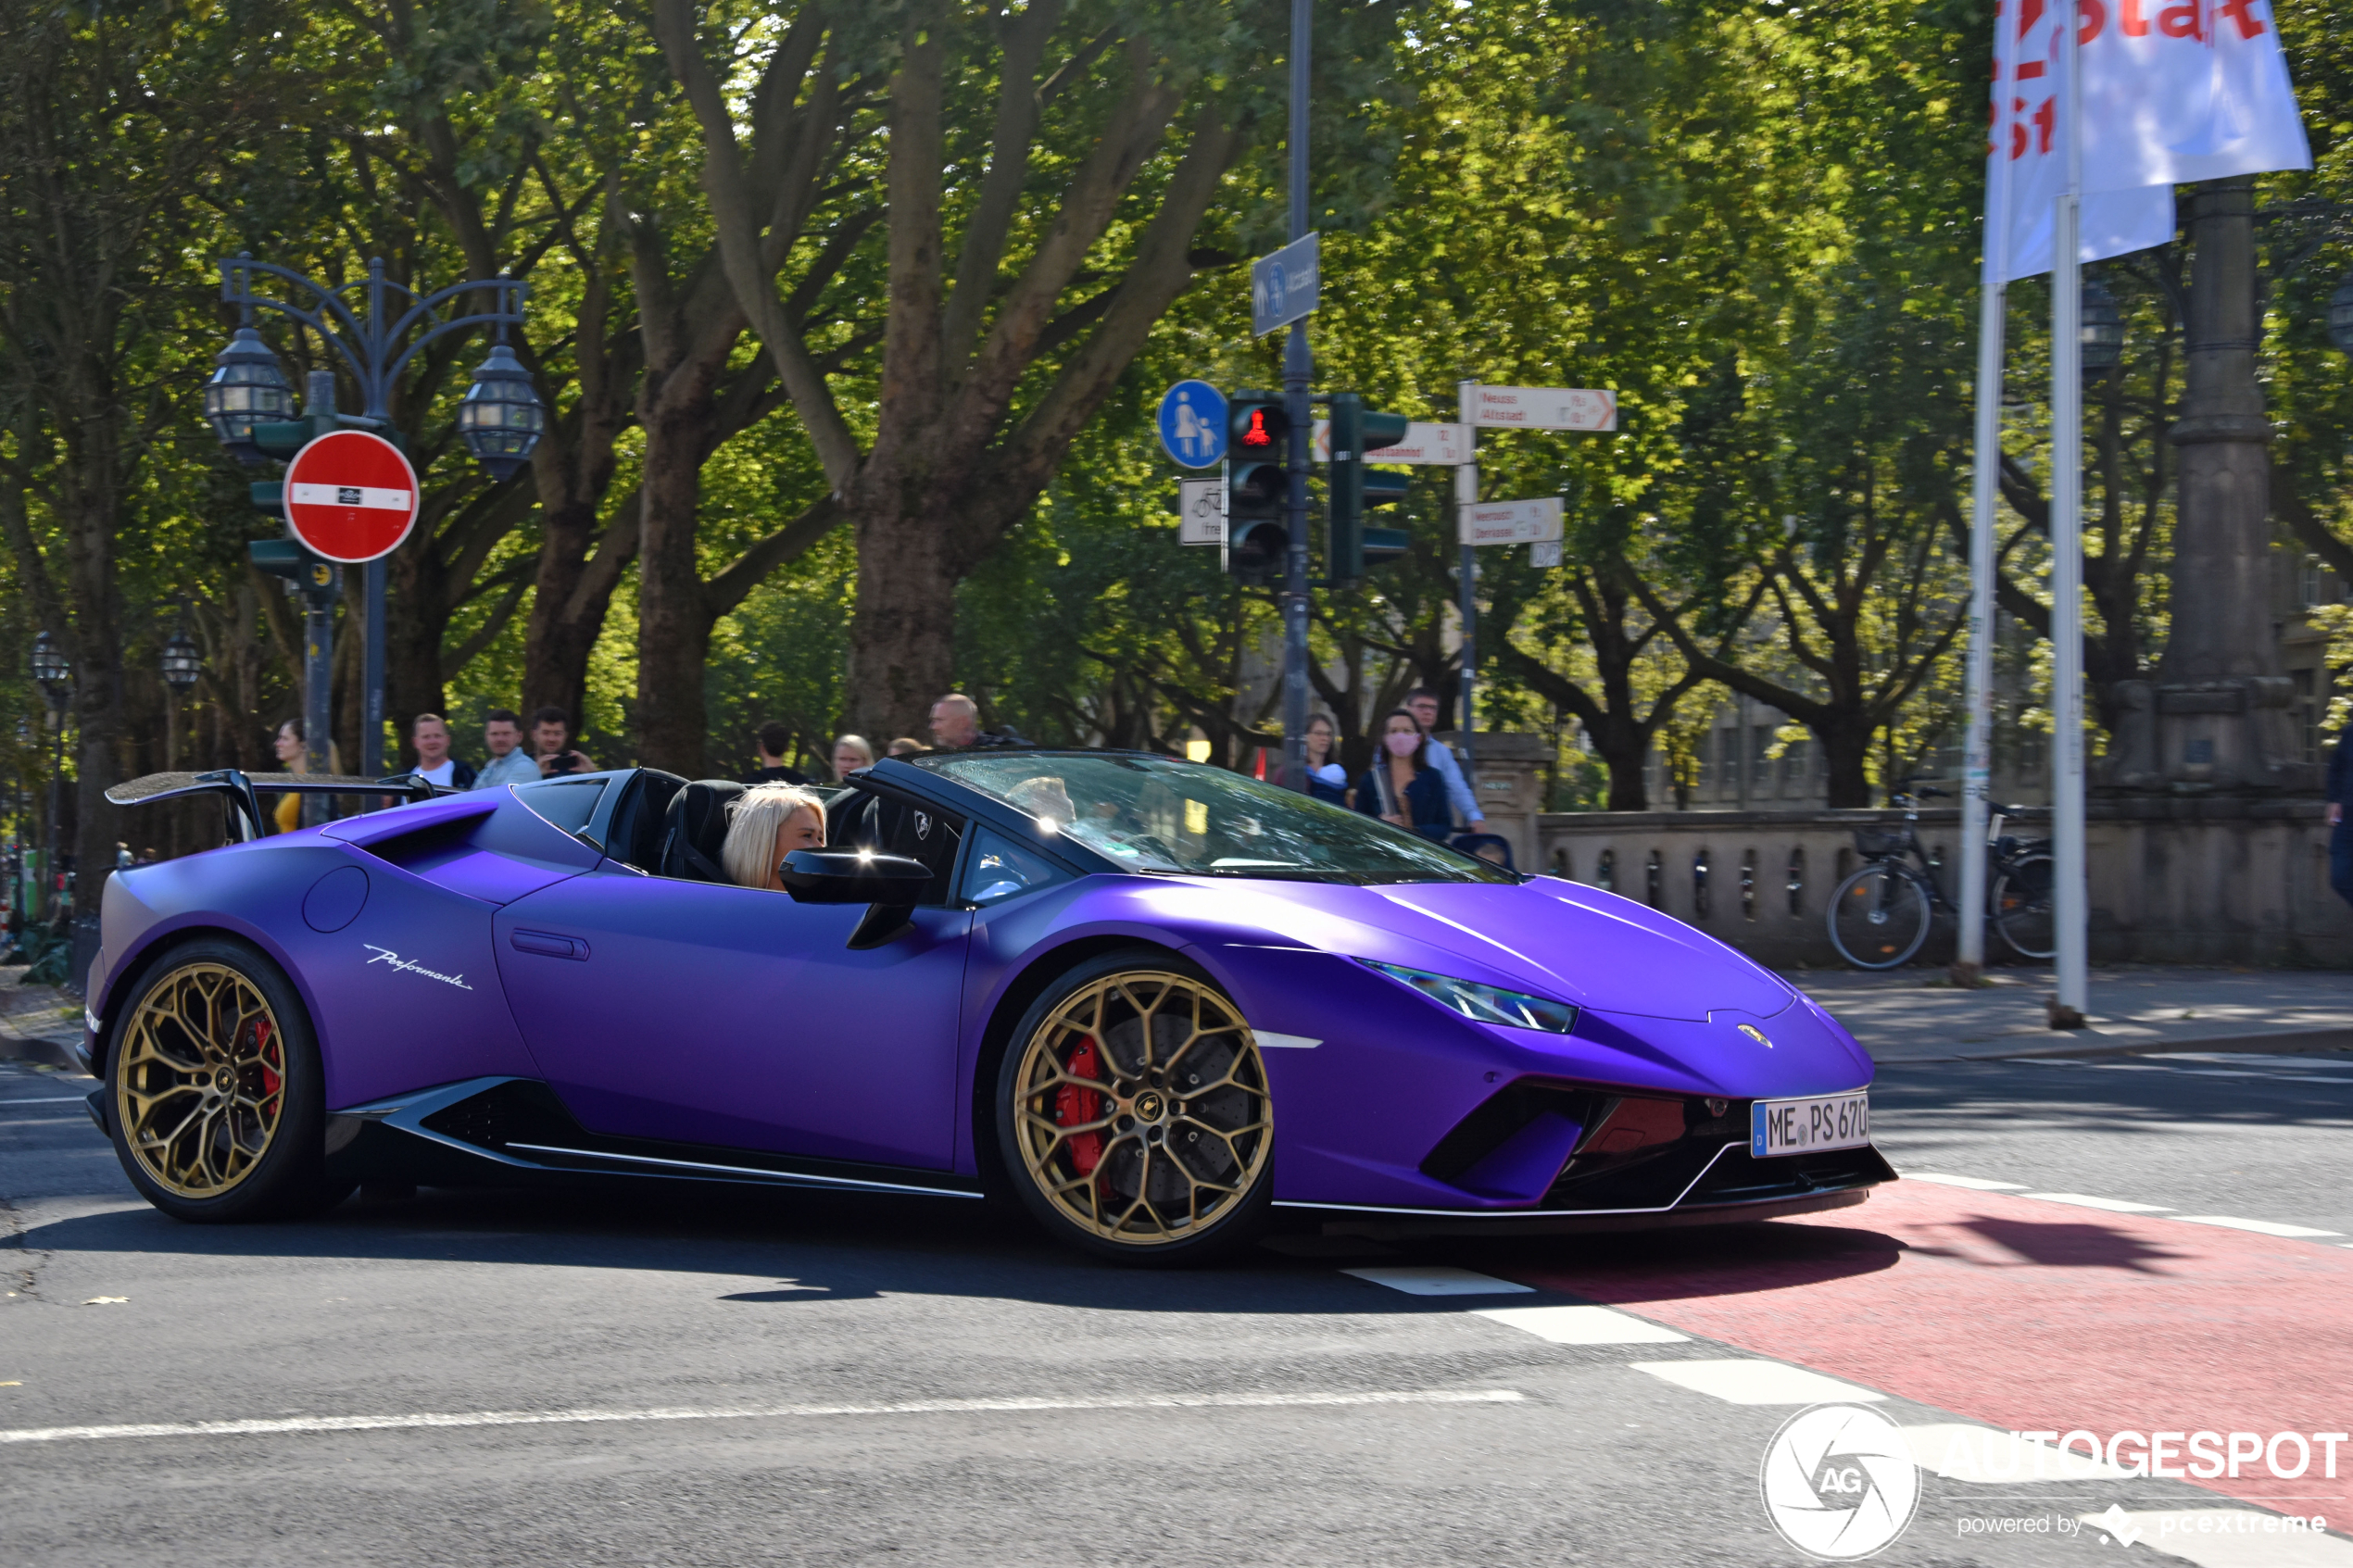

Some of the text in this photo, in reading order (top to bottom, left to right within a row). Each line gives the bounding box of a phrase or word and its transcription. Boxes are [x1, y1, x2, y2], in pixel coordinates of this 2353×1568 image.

[363, 944, 472, 990] Performante
[1756, 1135, 1763, 1147] D
[1768, 1099, 1868, 1148] ME PS 670
